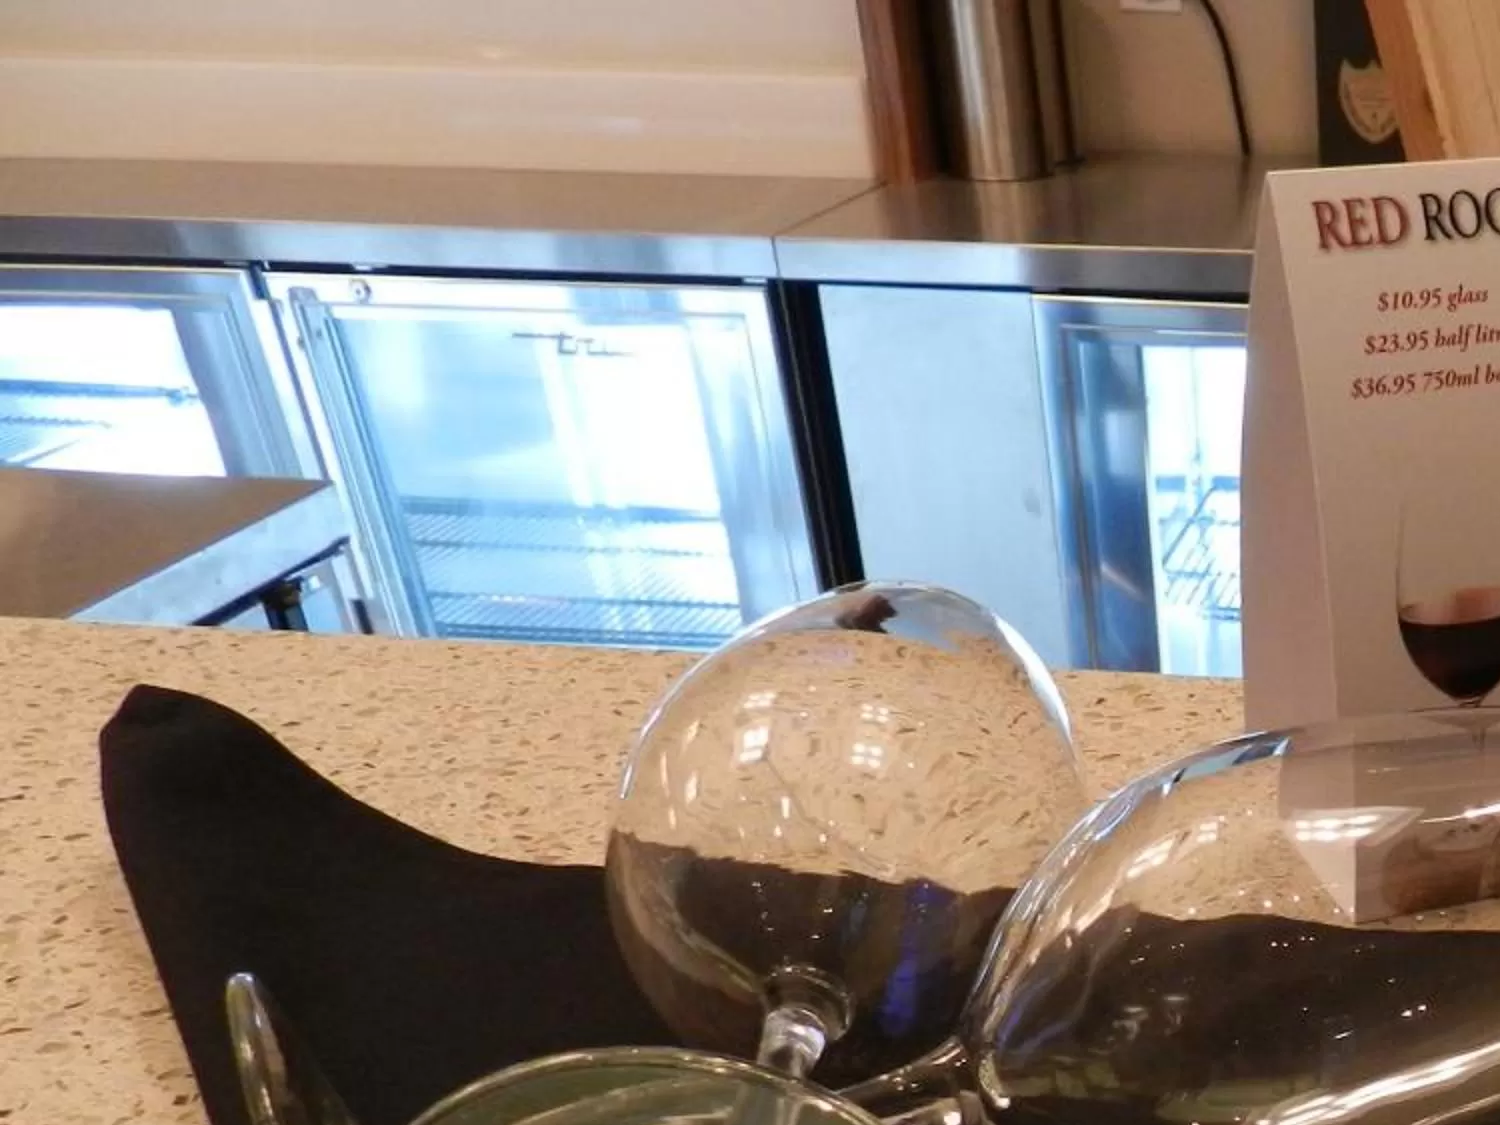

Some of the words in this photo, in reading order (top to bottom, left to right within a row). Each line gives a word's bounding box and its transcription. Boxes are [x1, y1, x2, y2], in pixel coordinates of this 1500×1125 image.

[1312, 196, 1411, 252] RED
[1377, 287, 1442, 312] $10.95
[1447, 284, 1490, 313] glass
[1363, 329, 1430, 355] $23.95
[1435, 323, 1475, 352] half
[1351, 373, 1417, 399] $36.95
[1423, 364, 1481, 392] 750ml
